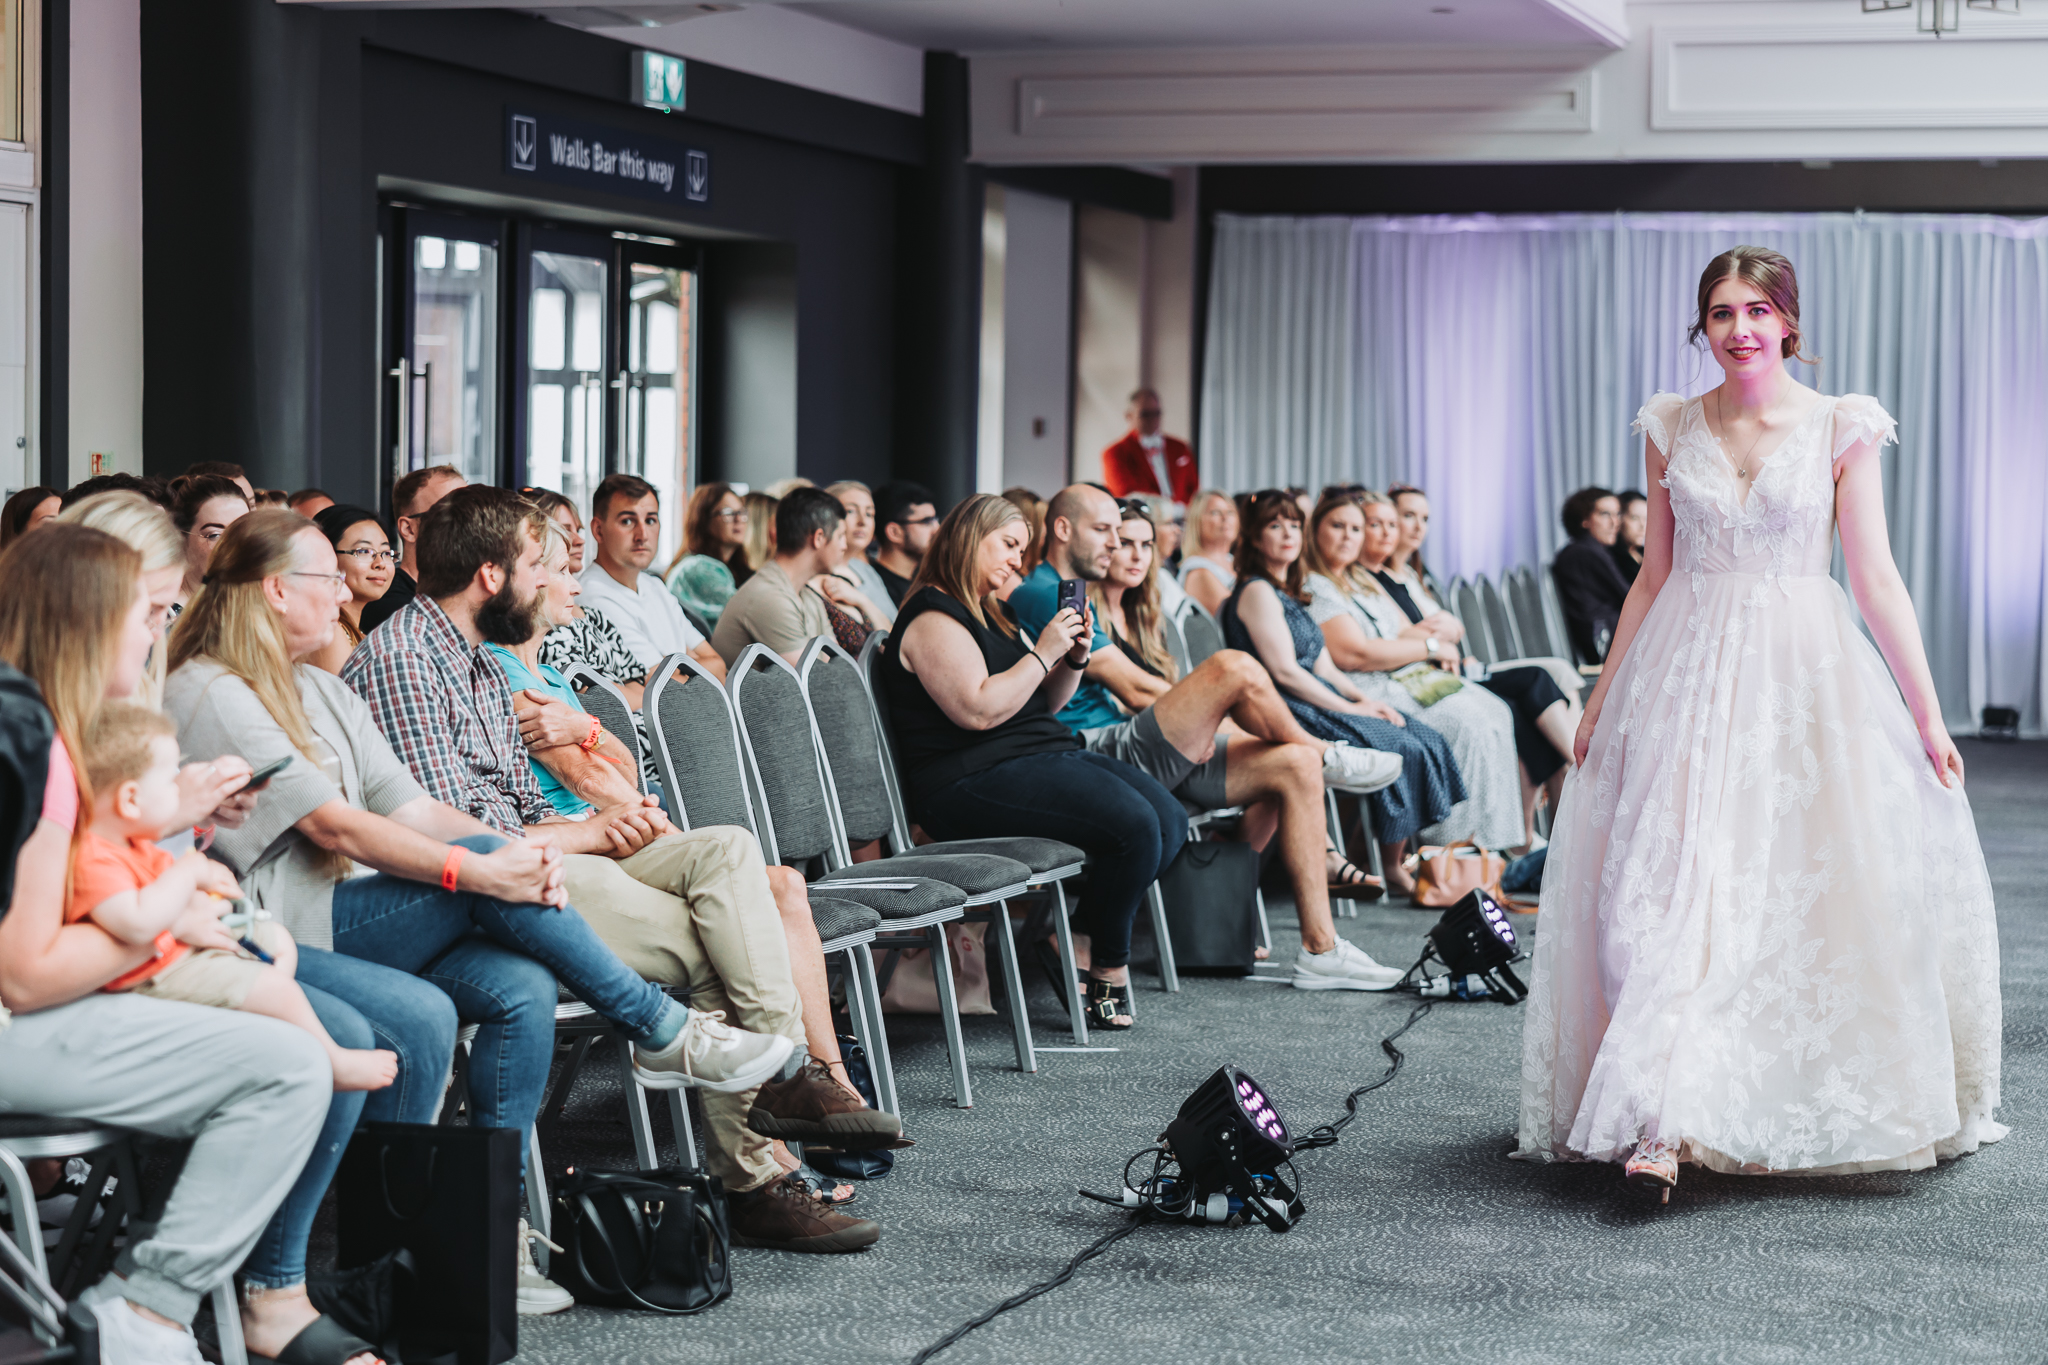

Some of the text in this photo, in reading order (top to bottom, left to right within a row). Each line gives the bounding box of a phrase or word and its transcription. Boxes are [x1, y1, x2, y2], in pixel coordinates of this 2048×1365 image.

[550, 133, 675, 192] Walls Bar this way
